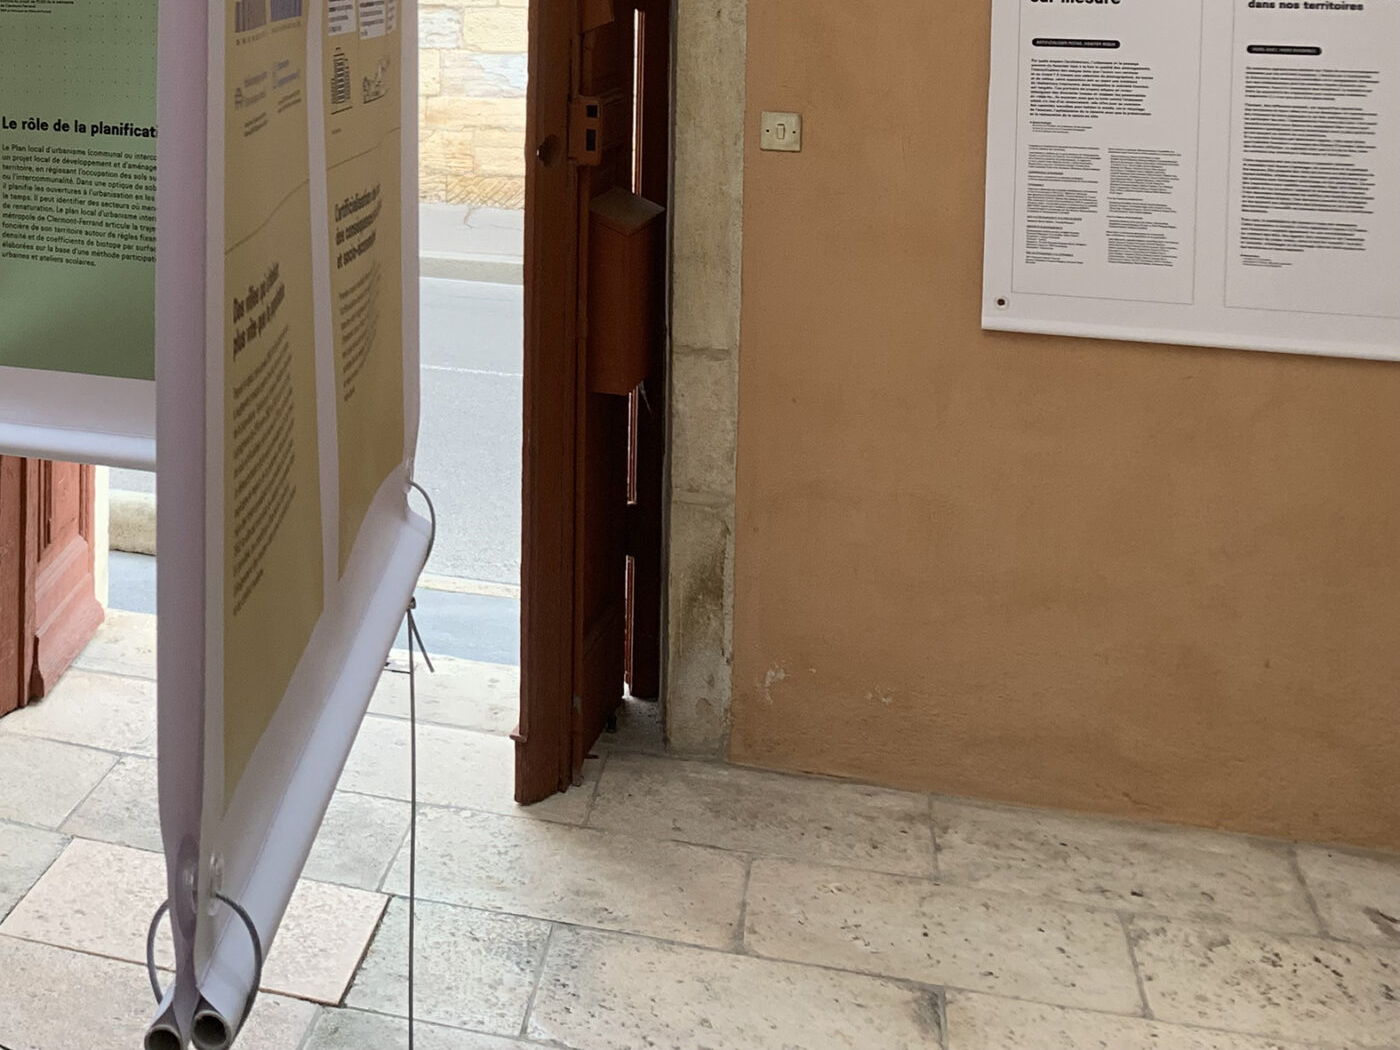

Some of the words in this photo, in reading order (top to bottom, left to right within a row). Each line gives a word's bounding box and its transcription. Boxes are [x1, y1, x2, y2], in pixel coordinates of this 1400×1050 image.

[1248, 0, 1275, 8] dans
[1303, 0, 1363, 10] territoires
[2, 116, 17, 130] Le
[21, 117, 48, 131] rôle
[52, 118, 69, 132] de
[74, 119, 86, 133] la
[90, 120, 156, 138] planificat
